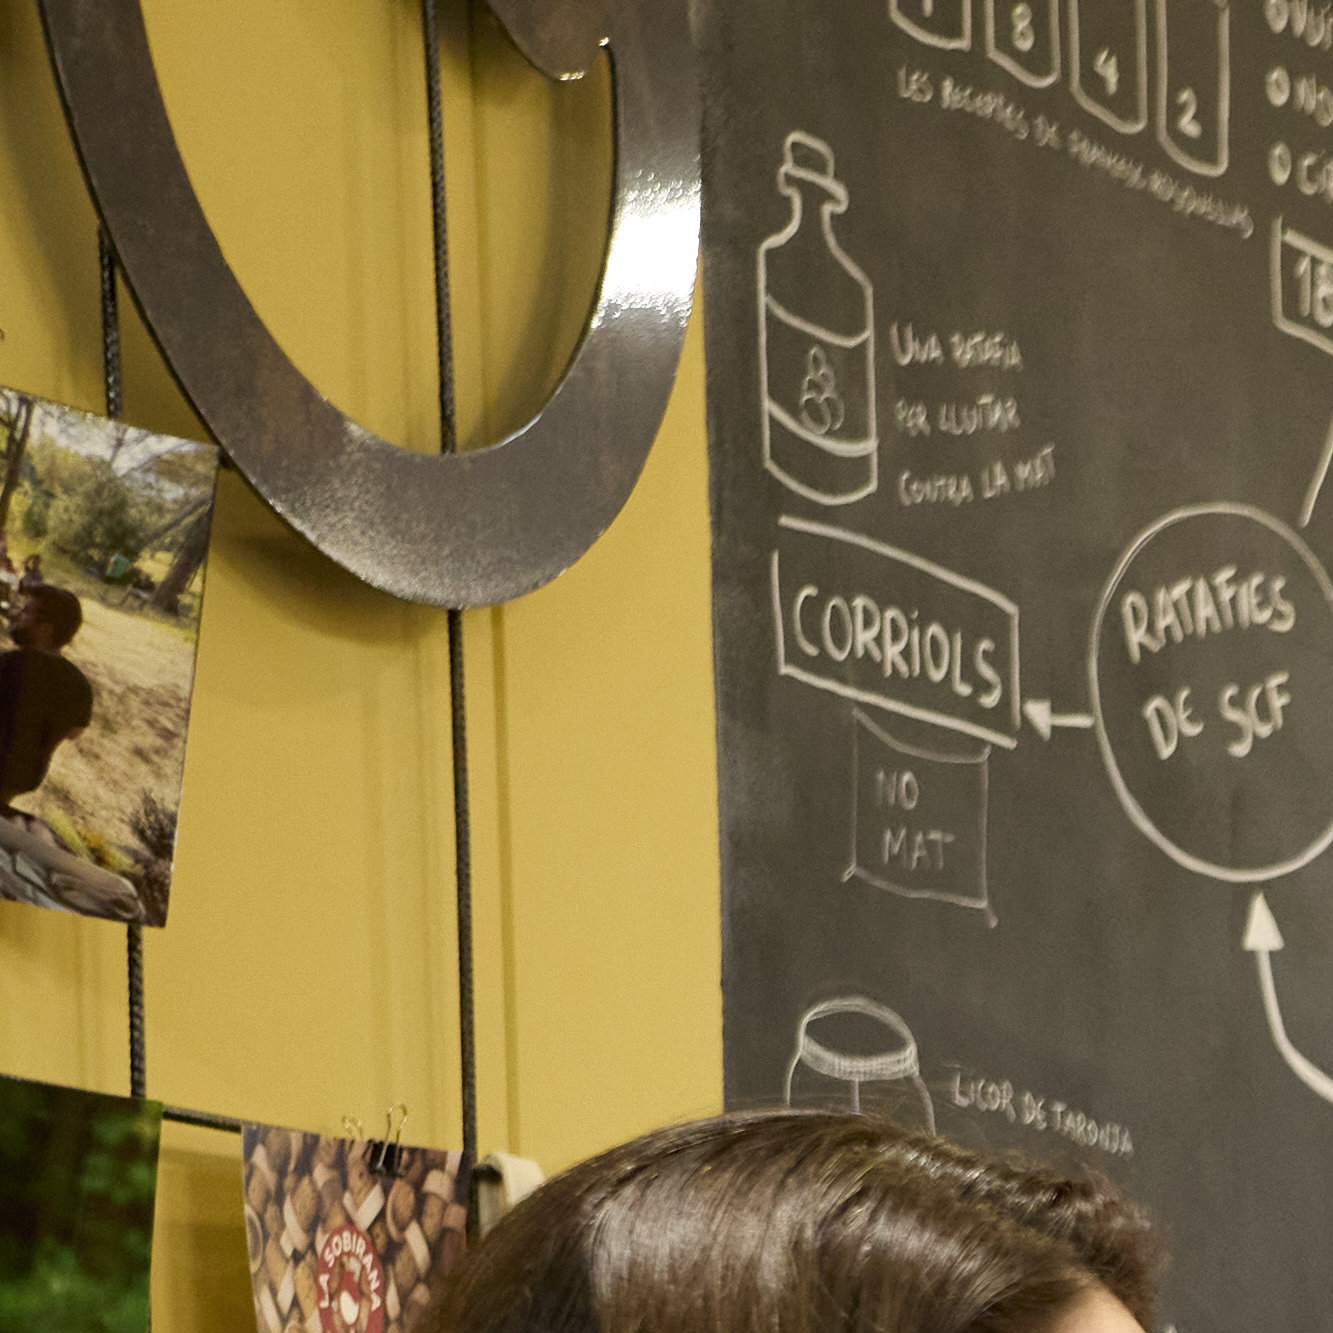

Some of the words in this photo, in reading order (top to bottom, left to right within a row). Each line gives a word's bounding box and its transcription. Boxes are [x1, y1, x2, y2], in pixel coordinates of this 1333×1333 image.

[1094, 47, 1119, 95] 4
[1176, 86, 1202, 138] 2
[981, 460, 1011, 499] LA
[1121, 564, 1297, 664] RATAFIES
[1143, 687, 1204, 760] DE
[1220, 671, 1291, 757] SCF
[874, 770, 920, 810] NO
[881, 829, 955, 871] MAT
[1022, 1090, 1048, 1131] DE
[323, 1230, 381, 1312] SOBIRANA
